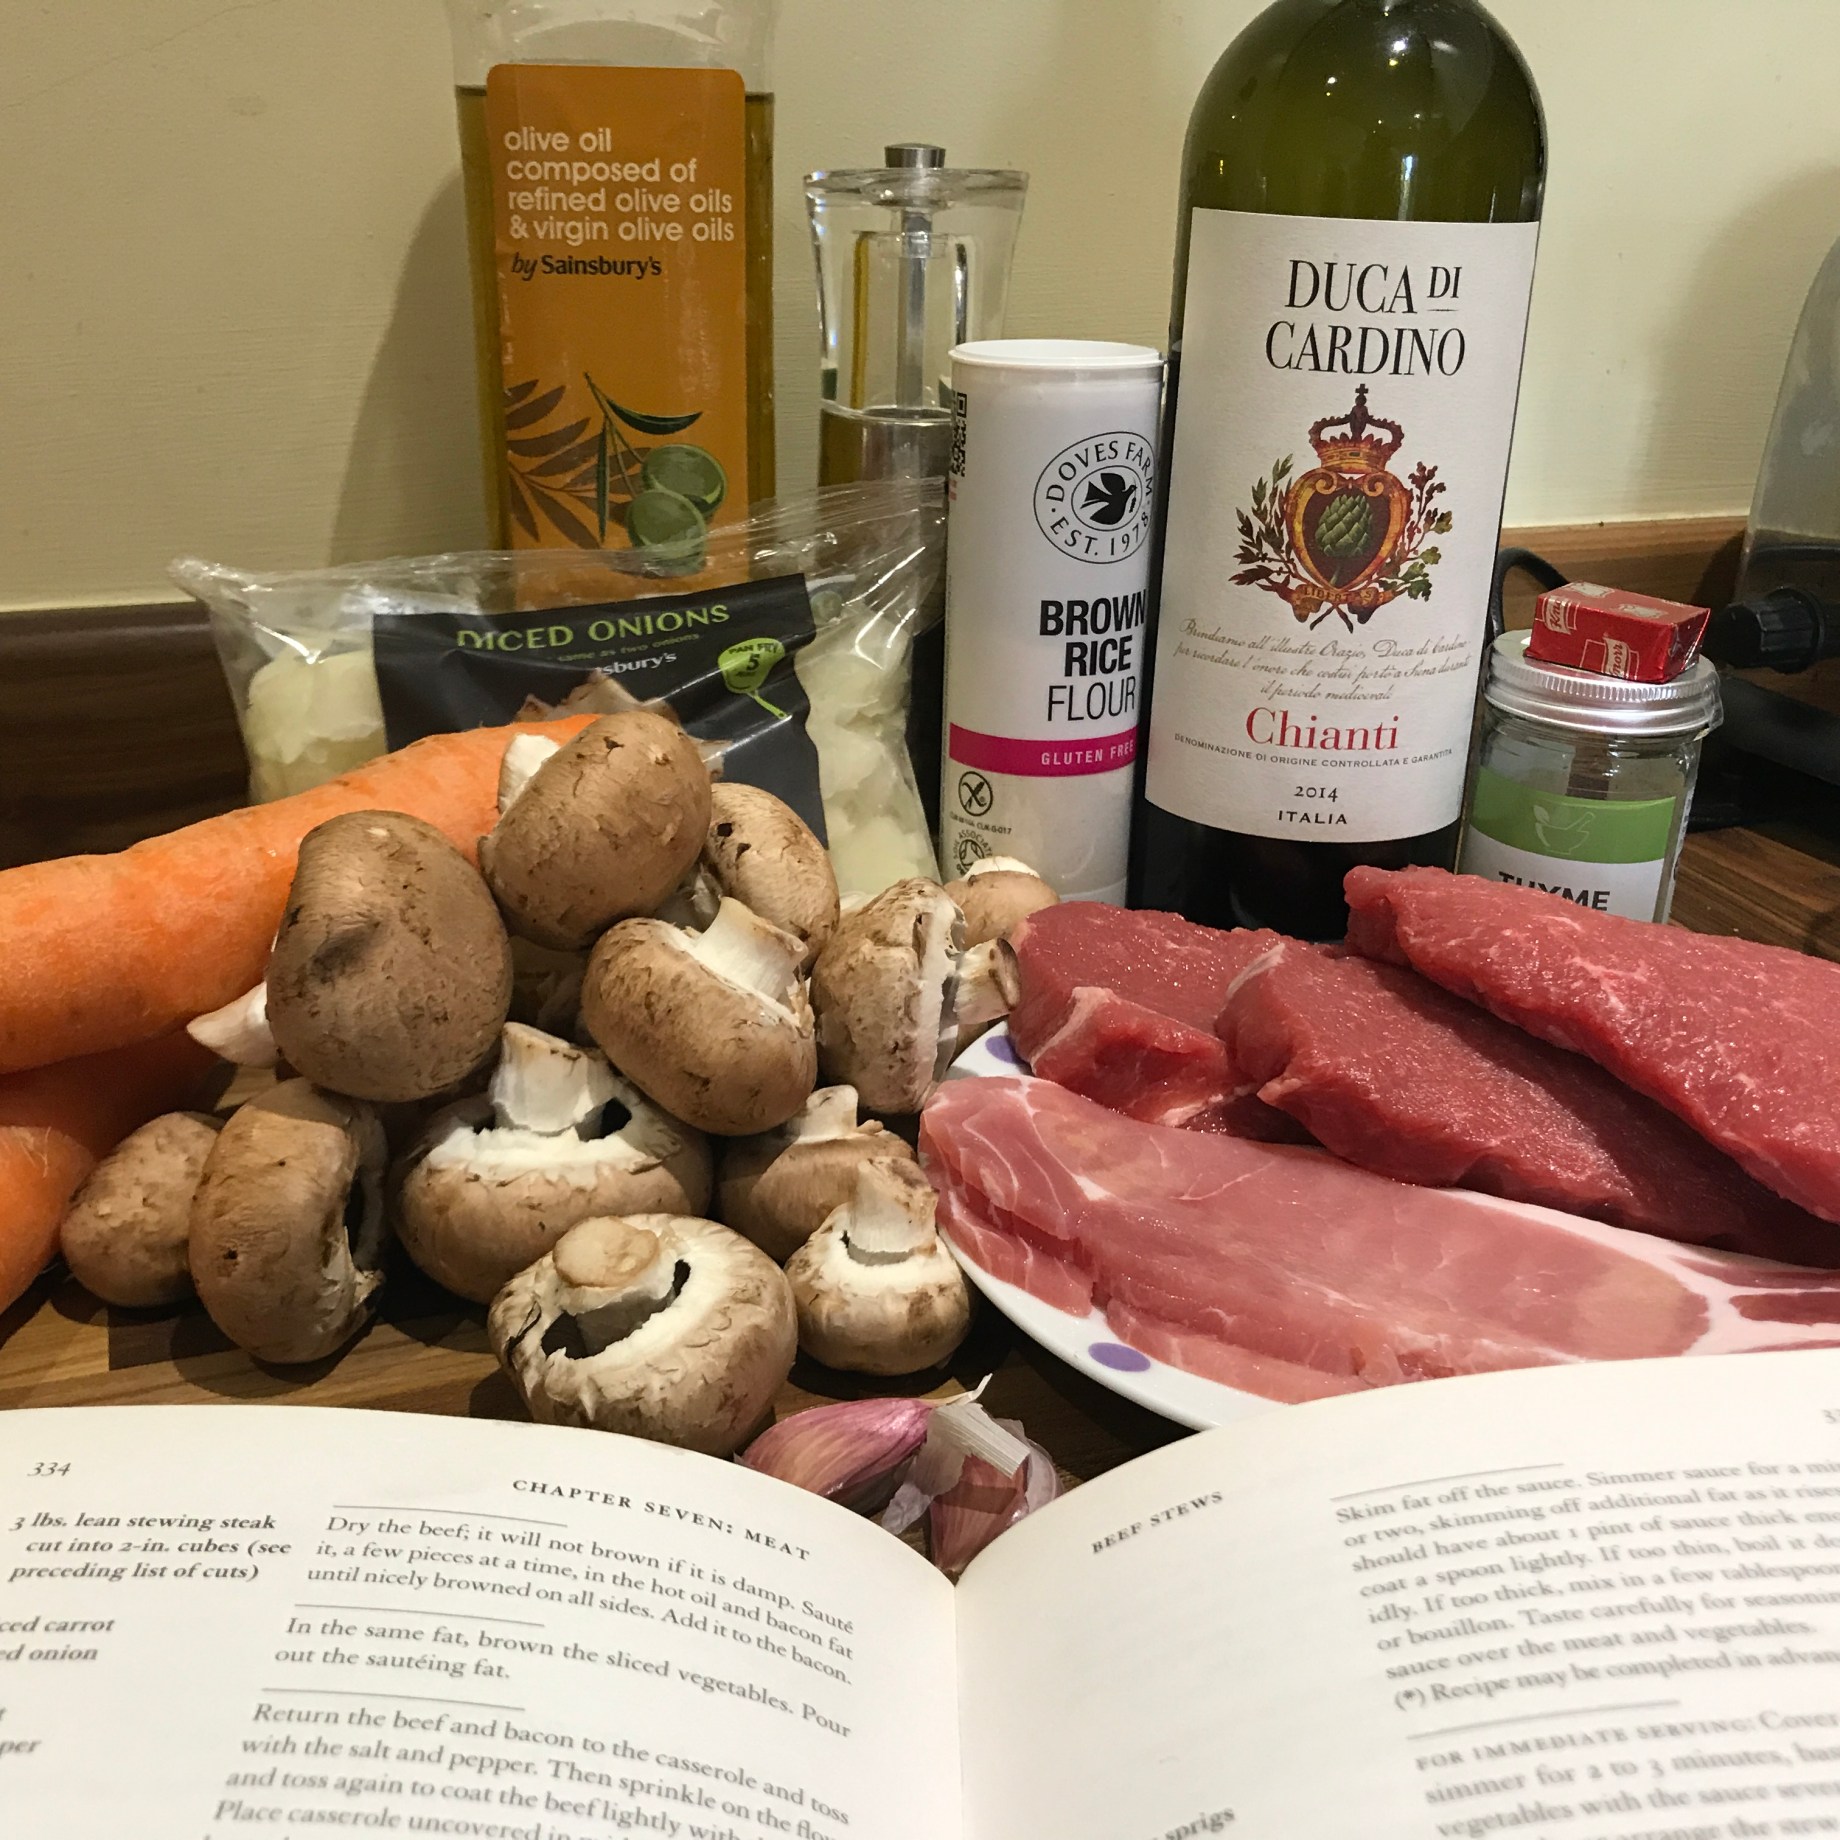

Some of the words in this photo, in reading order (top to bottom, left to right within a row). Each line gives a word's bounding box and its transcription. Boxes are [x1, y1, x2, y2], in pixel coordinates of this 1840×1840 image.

[504, 126, 570, 151] olive
[579, 128, 612, 152] oil
[507, 159, 660, 186] composed
[669, 158, 697, 183] of
[508, 187, 606, 212] refined
[615, 189, 681, 213] olive
[689, 189, 733, 214] oils
[509, 215, 530, 239] &
[533, 216, 609, 246] virgin
[618, 217, 683, 242] olive
[692, 217, 735, 242] oils
[511, 252, 538, 281] by
[541, 255, 662, 280] Sainsbury's
[1285, 259, 1418, 314] DUCA
[1427, 266, 1463, 299] DI
[1265, 320, 1466, 376] CARDINO
[1046, 440, 1119, 503] DOVES
[1125, 441, 1154, 496] FARM
[1050, 516, 1099, 556] EST.
[1111, 511, 1149, 556] 1978
[456, 625, 574, 652] DICED
[587, 604, 731, 641] ONIONS
[1039, 589, 1146, 636] BROWN
[597, 652, 678, 675] sbury's
[1064, 635, 1133, 677] RICE
[1047, 676, 1136, 722] FLOUR
[1246, 706, 1400, 750] Chianti
[1041, 749, 1103, 766] GLUTEN
[1110, 741, 1134, 760] FREE
[1174, 733, 1252, 760] DENOMINAZIONE
[1256, 753, 1267, 762] DI
[1270, 756, 1317, 767] ORIGINE
[1321, 758, 1400, 768] CONTROLLATA
[1402, 757, 1409, 765] E
[1294, 786, 1339, 803] 2014
[1278, 810, 1348, 825] ITALIA
[27, 1461, 71, 1477] 334
[1335, 1499, 1397, 1524] Skim
[1401, 1493, 1433, 1511] fat
[1437, 1486, 1469, 1504] off
[1474, 1482, 1510, 1499] the
[1585, 1470, 1675, 1487] Simmer
[1681, 1466, 1742, 1480] sauce
[9, 1517, 26, 1532] 3
[31, 1511, 68, 1528] lbs.
[74, 1512, 121, 1528] lean
[126, 1514, 216, 1532] stewing
[220, 1514, 277, 1530] steak
[512, 1479, 631, 1509] CHAPTER
[644, 1501, 733, 1535] SEVEN:
[744, 1528, 811, 1561] MEAT
[1091, 1521, 1143, 1555] BEEF
[1150, 1490, 1224, 1527] STEWS
[25, 1540, 63, 1553] cut
[67, 1538, 114, 1553] into
[118, 1539, 170, 1553] 2-in.
[177, 1538, 240, 1554] cubes
[247, 1540, 292, 1558] (see
[8, 1562, 128, 1584] preceding
[131, 1562, 168, 1578] list
[173, 1562, 202, 1578] of
[203, 1564, 260, 1582] cuts)
[326, 1516, 370, 1536] Dry
[377, 1518, 412, 1534] the
[418, 1520, 470, 1541] beef;
[477, 1526, 492, 1541] it
[501, 1531, 541, 1548] will
[548, 1539, 584, 1554] not
[591, 1541, 660, 1569] brown
[668, 1558, 688, 1574] if
[689, 1565, 705, 1580] it
[711, 1569, 727, 1586] is
[732, 1576, 796, 1610] damp.
[802, 1600, 854, 1634] Sauté
[316, 1541, 337, 1557] it,
[343, 1546, 355, 1557] a
[362, 1541, 403, 1558] few
[407, 1549, 474, 1568] pieces
[478, 1554, 499, 1568] at
[504, 1559, 516, 1570] a
[523, 1559, 578, 1580] time,
[584, 1566, 605, 1584] in
[612, 1571, 645, 1590] the
[650, 1577, 685, 1600] hot
[690, 1591, 717, 1609] oil
[722, 1602, 760, 1622] and
[766, 1610, 823, 1646] bacon
[829, 1637, 853, 1660] fat
[0, 1616, 41, 1633] ced
[44, 1619, 115, 1633] carrot
[307, 1566, 360, 1582] until
[364, 1569, 428, 1588] nicely
[433, 1571, 532, 1598] browned
[536, 1588, 562, 1602] on
[568, 1589, 594, 1607] all
[599, 1597, 655, 1619] sides.
[662, 1608, 708, 1632] Add
[713, 1621, 729, 1639] it
[732, 1628, 752, 1645] to
[756, 1633, 788, 1657] the
[791, 1645, 852, 1685] bacon.
[28, 1644, 98, 1661] onion
[274, 1650, 314, 1663] out
[322, 1647, 360, 1665] the
[365, 1654, 466, 1678] sautéing
[473, 1658, 510, 1679] fat.
[286, 1617, 312, 1634] In
[320, 1618, 358, 1636] the
[364, 1626, 425, 1642] same
[432, 1626, 469, 1648] fat,
[478, 1630, 554, 1656] brown
[563, 1642, 599, 1663] the
[606, 1650, 670, 1677] sliced
[678, 1669, 794, 1714] vegetables.
[802, 1703, 852, 1738] Pour
